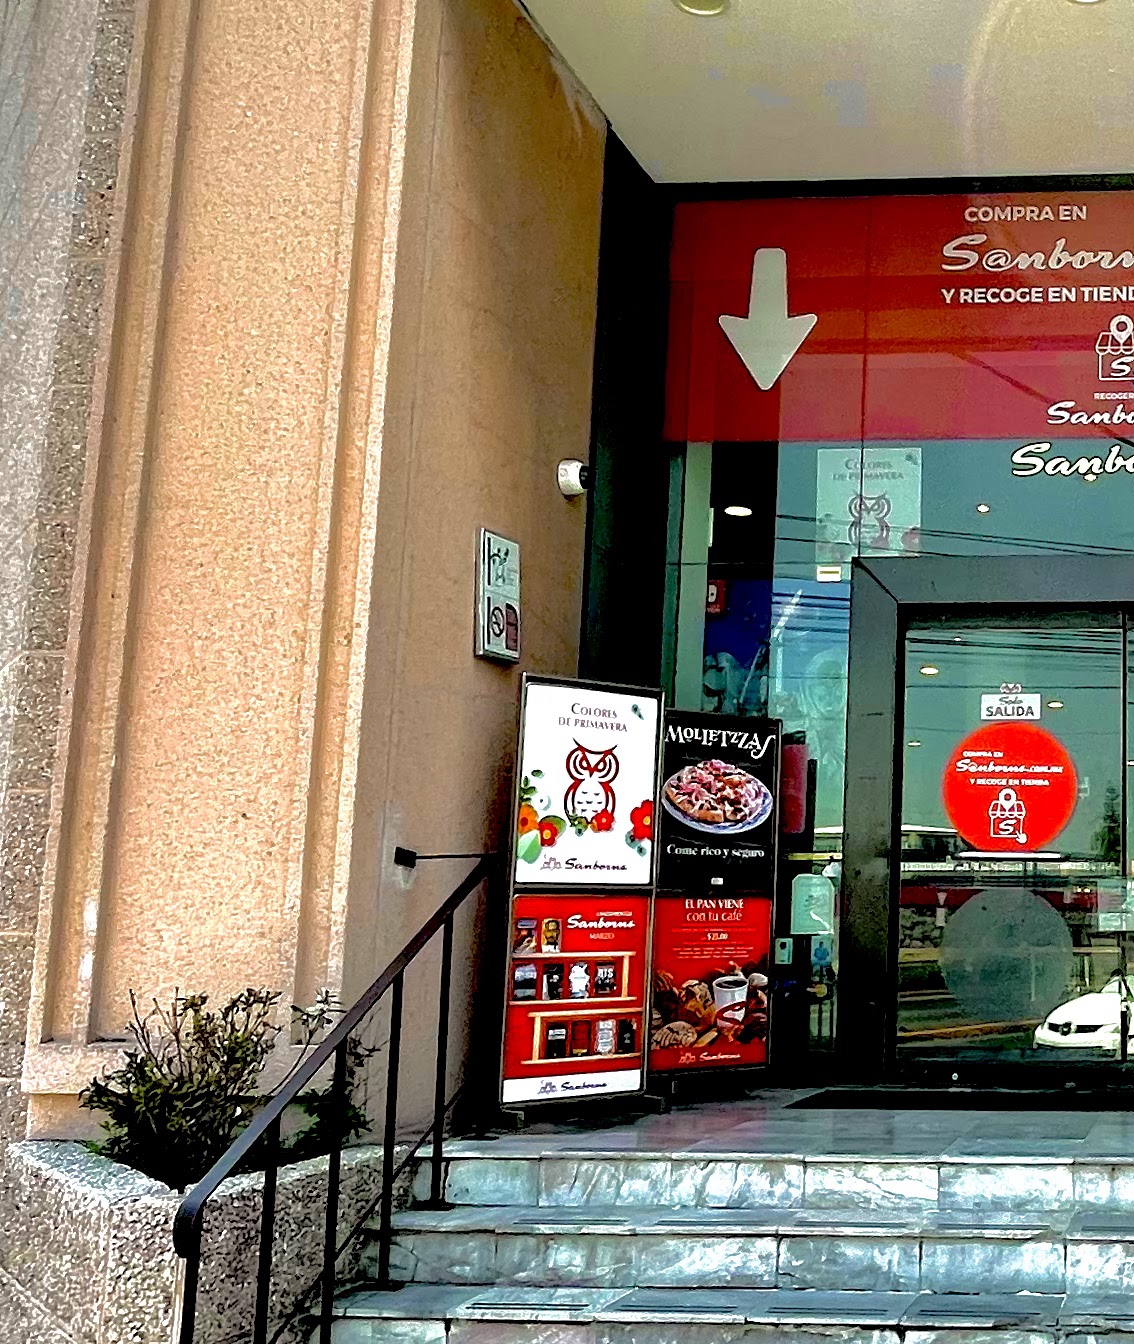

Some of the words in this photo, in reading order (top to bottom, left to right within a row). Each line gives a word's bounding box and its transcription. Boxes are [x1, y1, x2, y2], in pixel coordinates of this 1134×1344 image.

[964, 205, 1054, 223] COMPRA
[1058, 205, 1087, 221] EN
[941, 288, 956, 304] Y
[959, 287, 1044, 304] RECOGE
[1048, 287, 1076, 303] EN
[1094, 392, 1134, 400] RECOGER
[571, 703, 618, 719] COLORES
[986, 706, 1035, 717] SALIDA
[558, 716, 571, 726] DE
[573, 718, 628, 733] PRIMAVERA
[665, 725, 776, 759] MOLLETZZAS
[667, 844, 698, 856] Come
[701, 846, 721, 856] rico
[723, 849, 730, 858] y
[731, 848, 765, 858] seguro
[564, 857, 628, 871] Sanborns
[685, 899, 695, 909] EL
[697, 899, 716, 909] PAN
[718, 899, 744, 909] VIENE
[567, 914, 636, 929] Sanborns
[686, 911, 706, 921] con
[708, 911, 719, 921] tu
[721, 909, 743, 921] café
